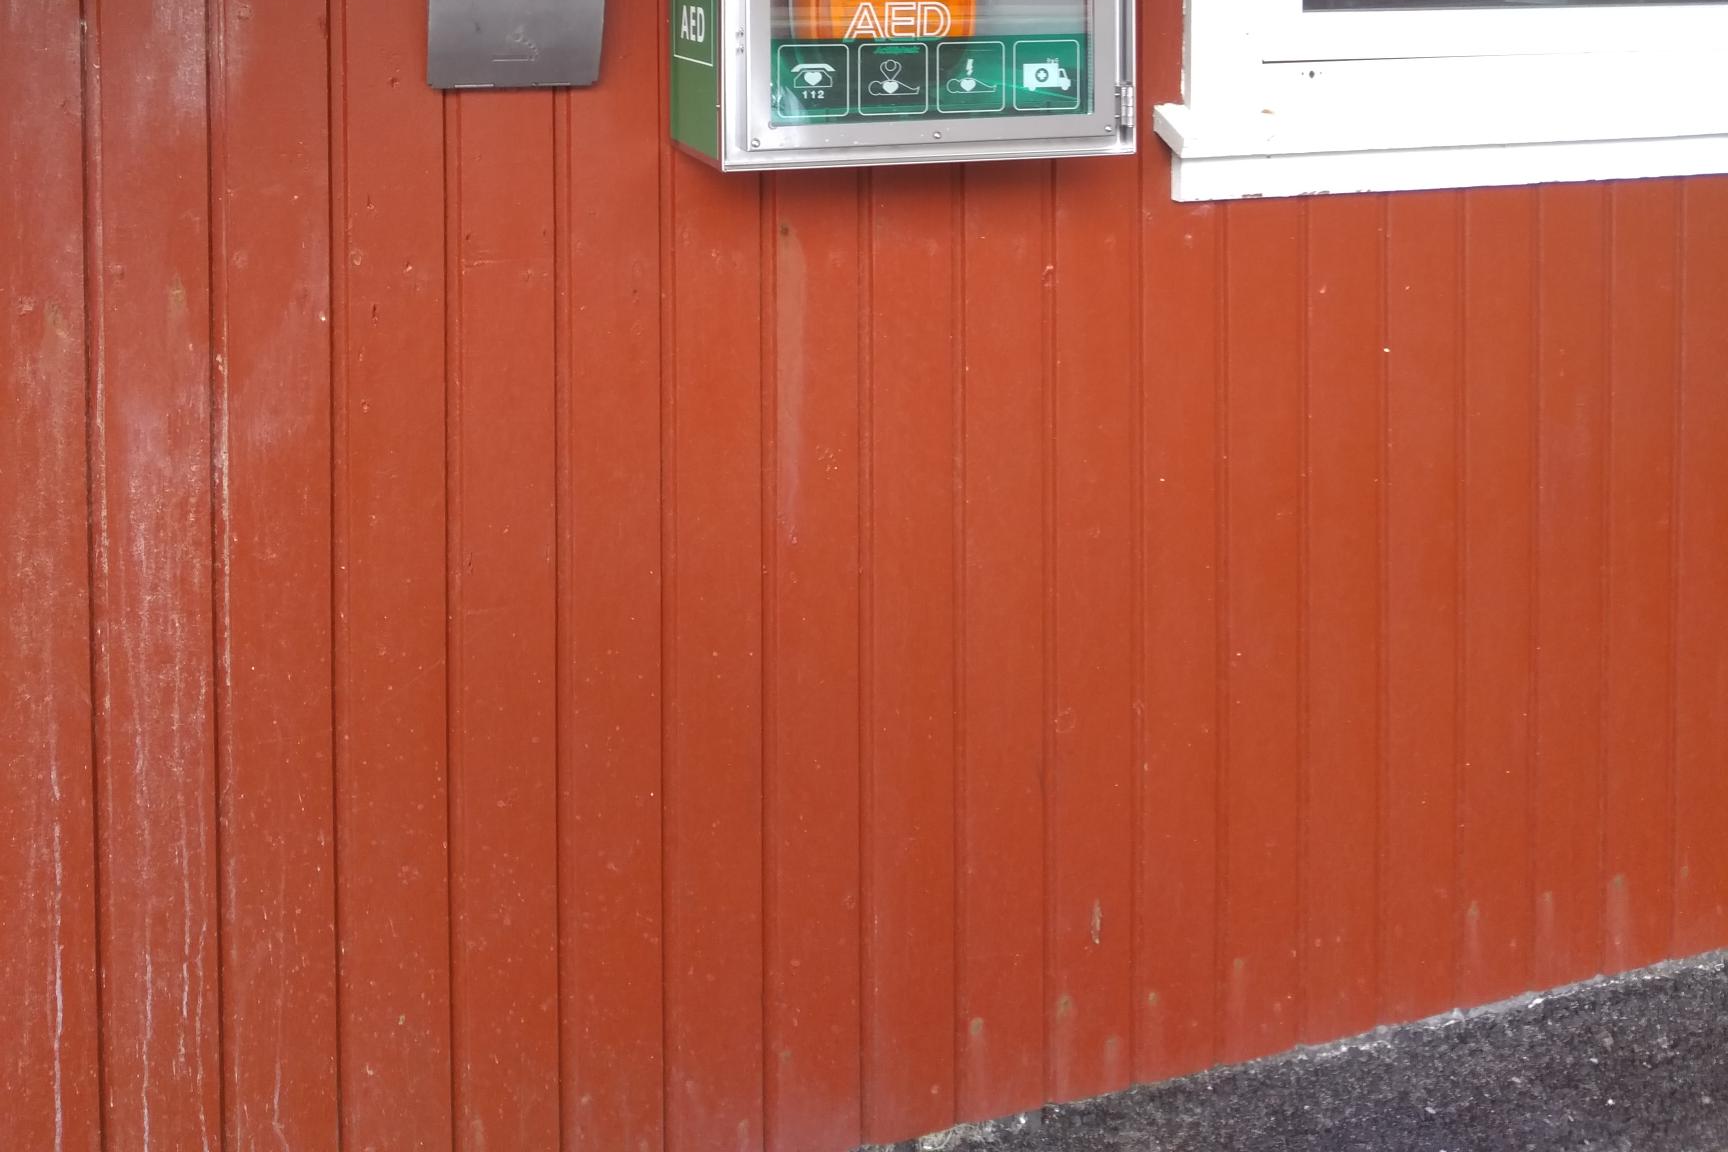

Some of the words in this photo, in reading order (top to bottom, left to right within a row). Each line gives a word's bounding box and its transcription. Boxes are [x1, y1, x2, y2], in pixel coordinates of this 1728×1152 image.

[680, 5, 705, 42] AED
[843, 1, 951, 42] AED
[802, 90, 825, 99] 112
